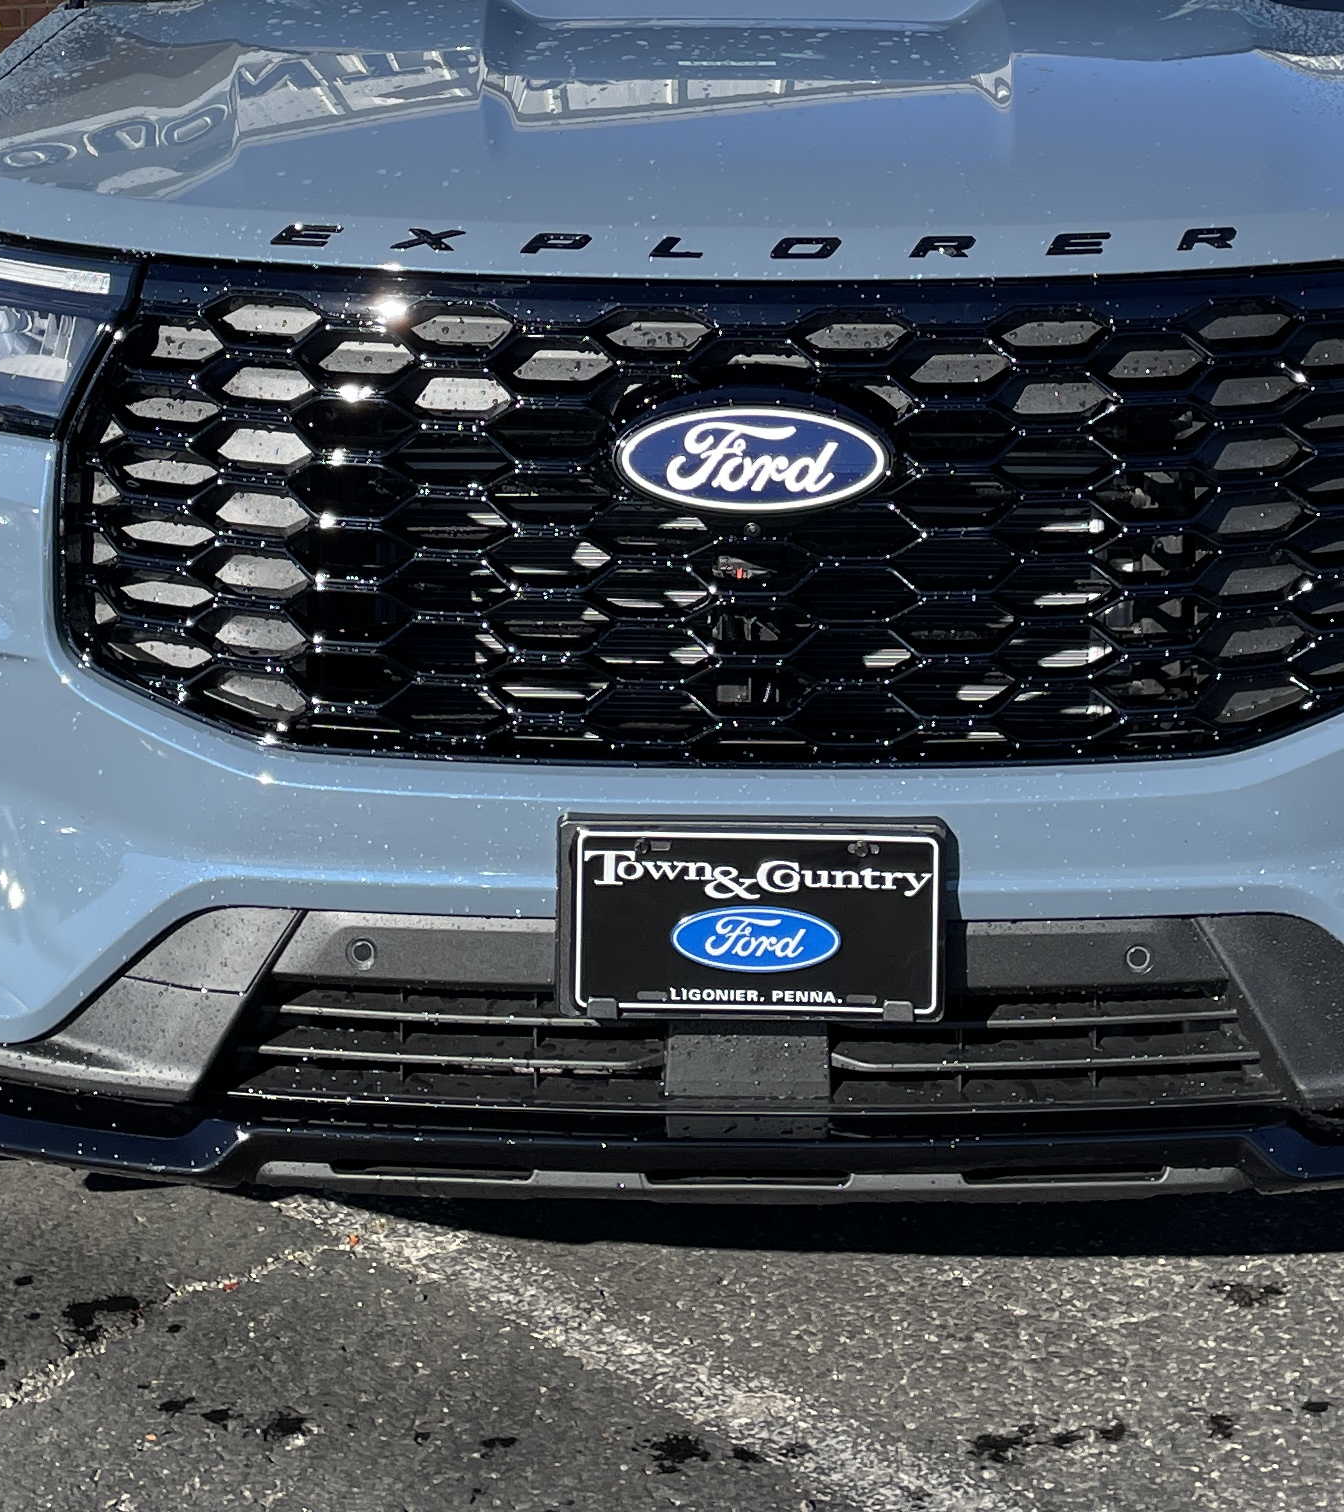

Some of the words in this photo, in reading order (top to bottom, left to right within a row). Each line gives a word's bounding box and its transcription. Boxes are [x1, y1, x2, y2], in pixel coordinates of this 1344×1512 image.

[270, 223, 1238, 261] EXPLORER
[666, 421, 839, 493] Ford
[704, 915, 807, 958] Ford
[772, 990, 843, 1004] PENNA.
